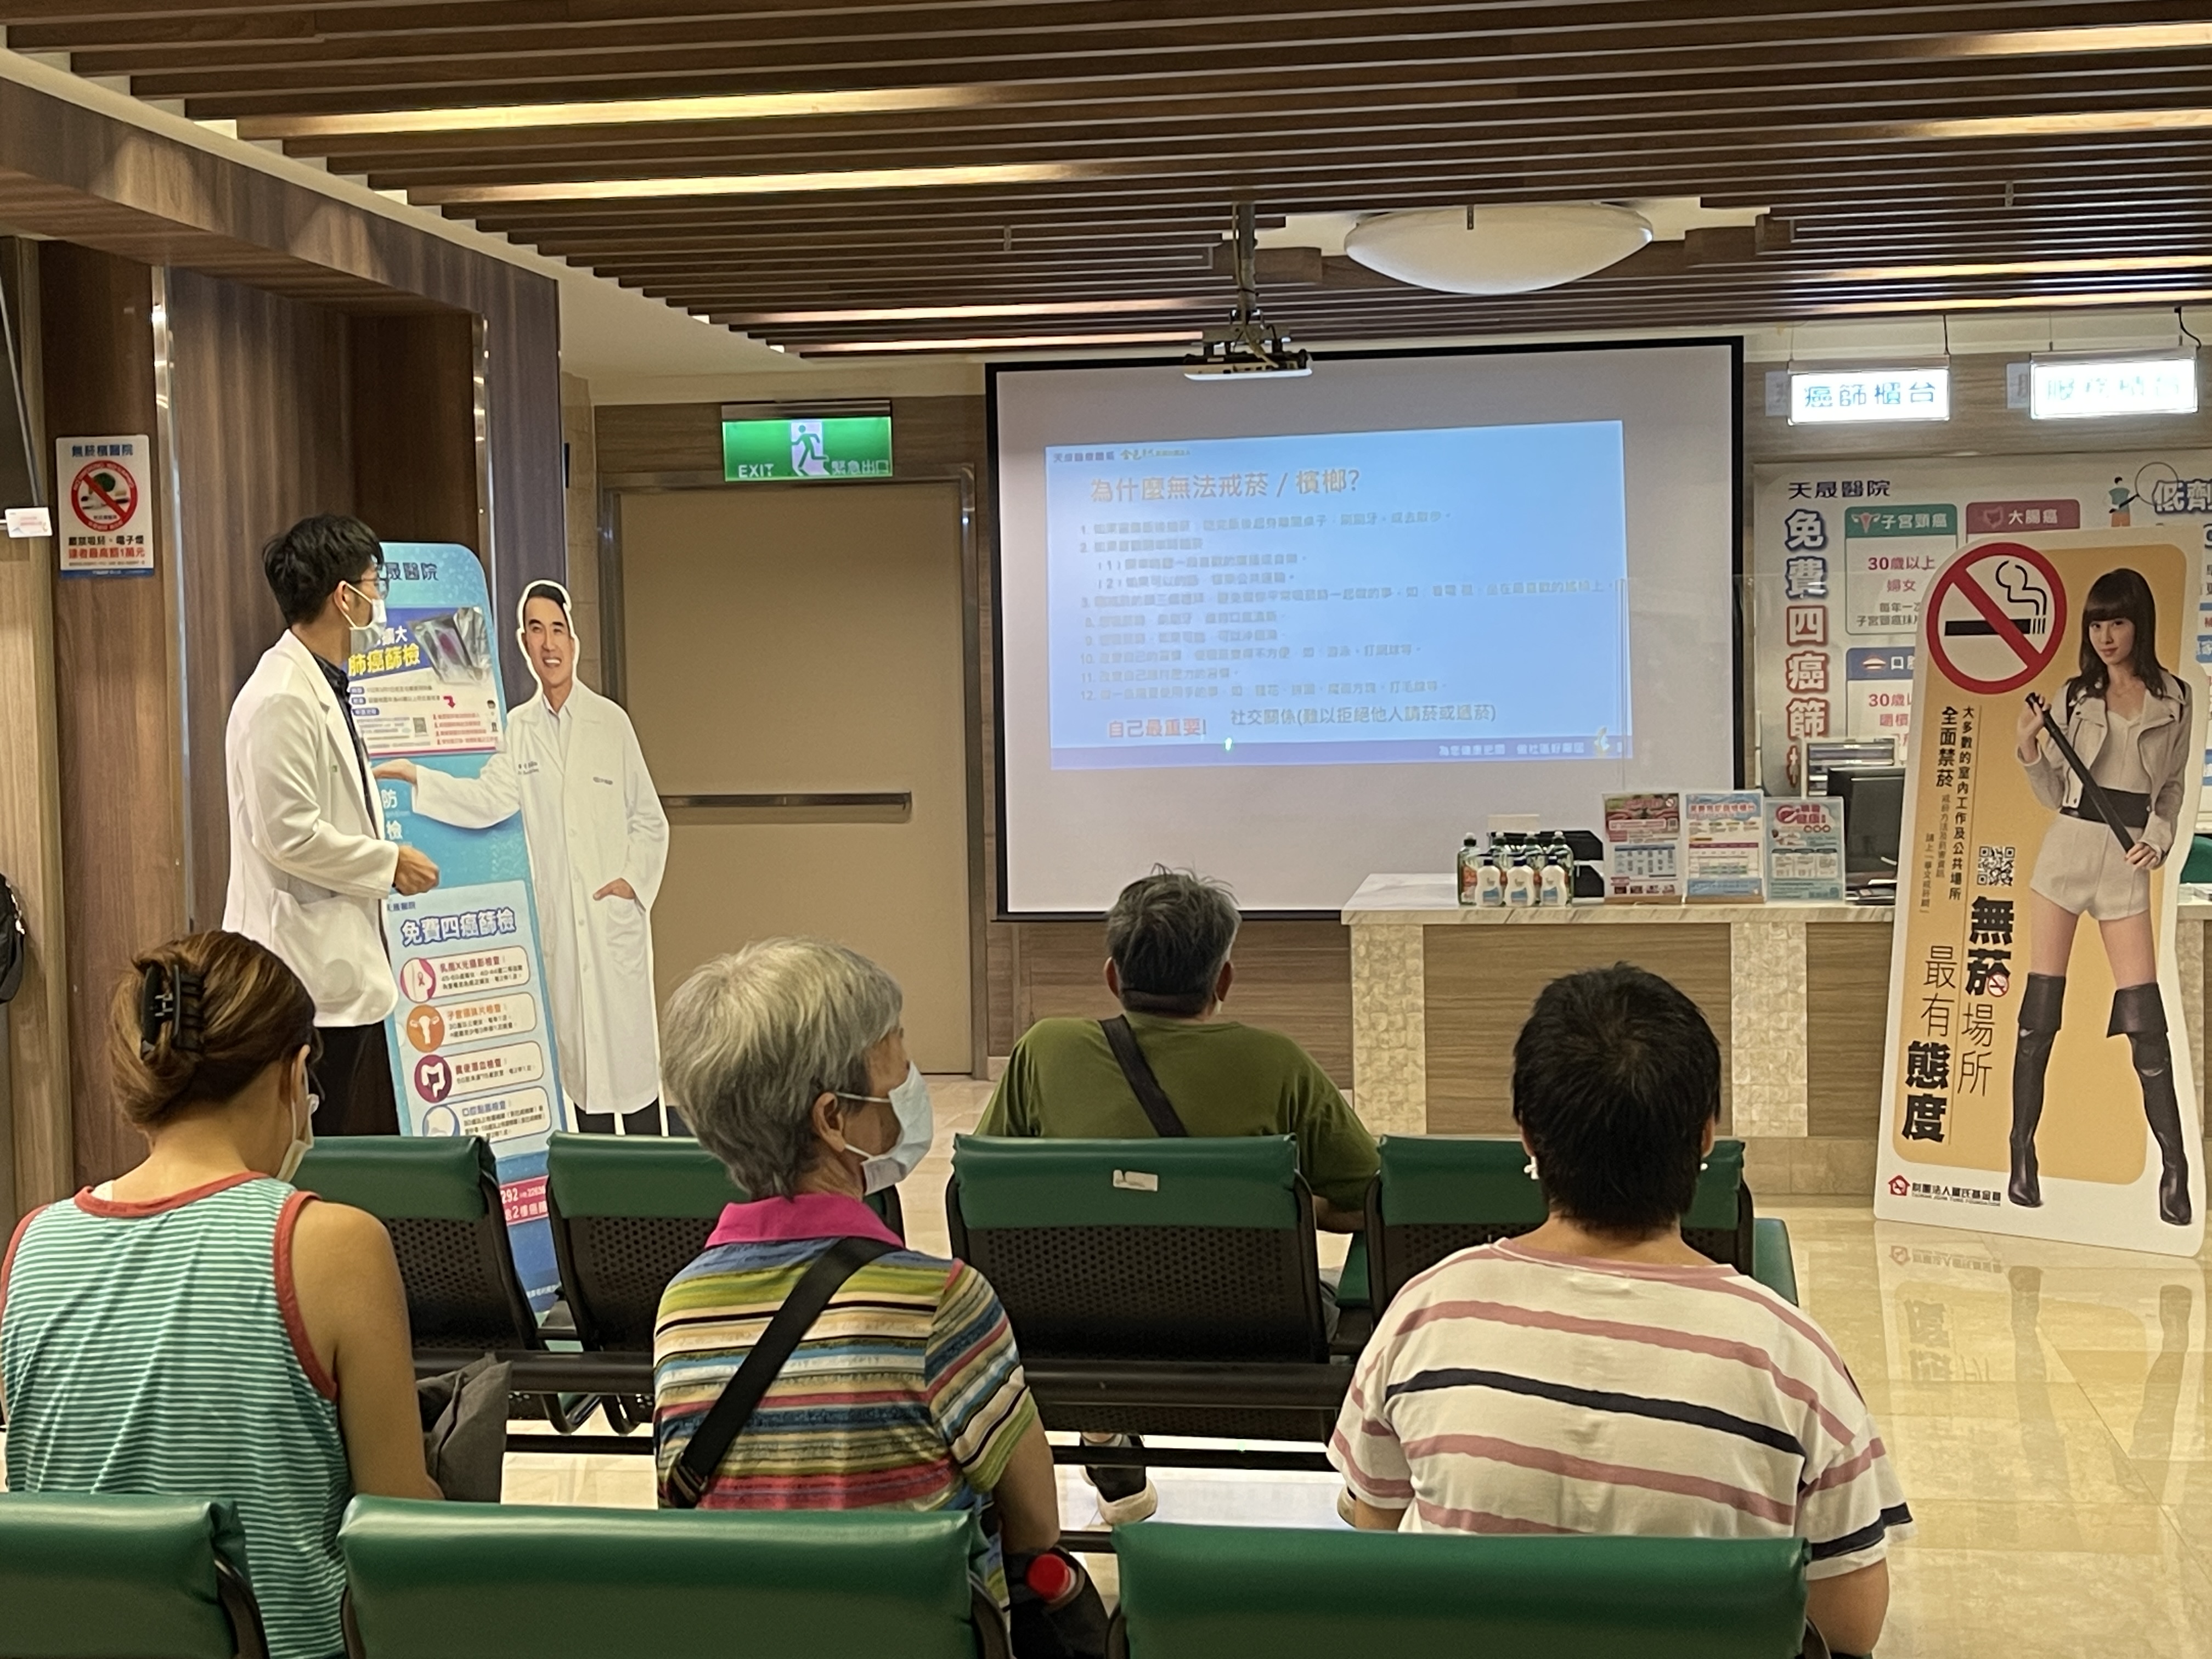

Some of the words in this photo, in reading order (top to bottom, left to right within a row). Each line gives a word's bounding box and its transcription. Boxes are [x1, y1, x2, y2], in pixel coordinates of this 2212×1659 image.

[738, 464, 774, 478] EXIT
[831, 459, 889, 476] 緊急出口
[1090, 473, 1268, 503] 為什麼無法戒菸
[1275, 472, 1289, 498] /
[1296, 468, 1361, 495] 檳榔?
[1787, 480, 1891, 500] 天晟醫院
[1881, 512, 1948, 530] 子宮頸癌
[2008, 509, 2058, 524] 大腸癌
[379, 562, 439, 581] 晟醫院
[1867, 556, 1936, 571] 30歲以上
[1887, 579, 1916, 593] 婦女
[377, 626, 408, 647] 擴大
[348, 642, 420, 676] 肺癌篩檢
[1108, 718, 1207, 738] 自己最重要!
[1936, 706, 1959, 788] 全面禁菸
[1948, 706, 1975, 901] 大多數的室內工作及公共場所
[400, 906, 516, 947] 免費四癌篩檢
[1956, 895, 2015, 1097] 無菸場所
[1901, 945, 1959, 1144] 最有態度
